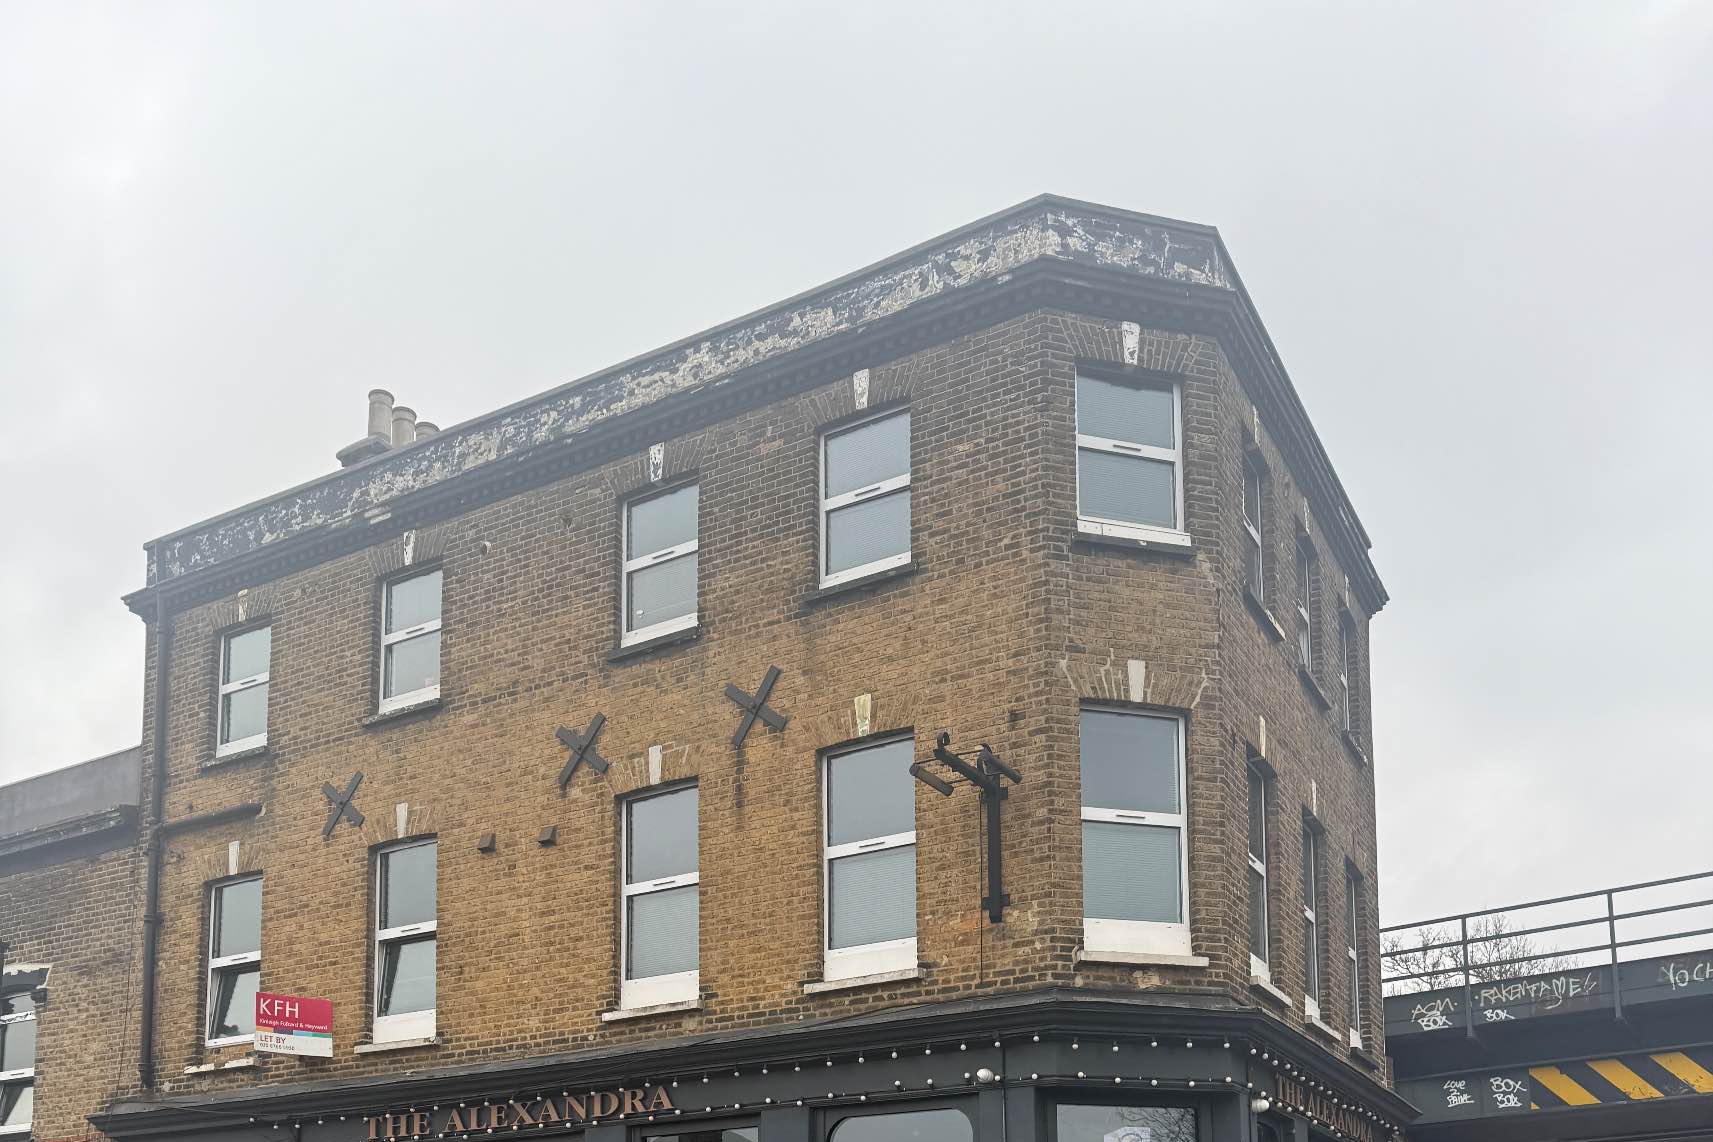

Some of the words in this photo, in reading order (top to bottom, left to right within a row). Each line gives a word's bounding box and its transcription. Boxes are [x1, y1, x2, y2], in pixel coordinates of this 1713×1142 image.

[260, 997, 299, 1019] KFH
[260, 1034, 273, 1042] LET
[275, 1036, 286, 1044] BY
[1276, 1072, 1304, 1108] THE
[1490, 1077, 1527, 1093] BOX
[364, 1112, 430, 1141] THE
[443, 1086, 675, 1133] ALEXANDRA
